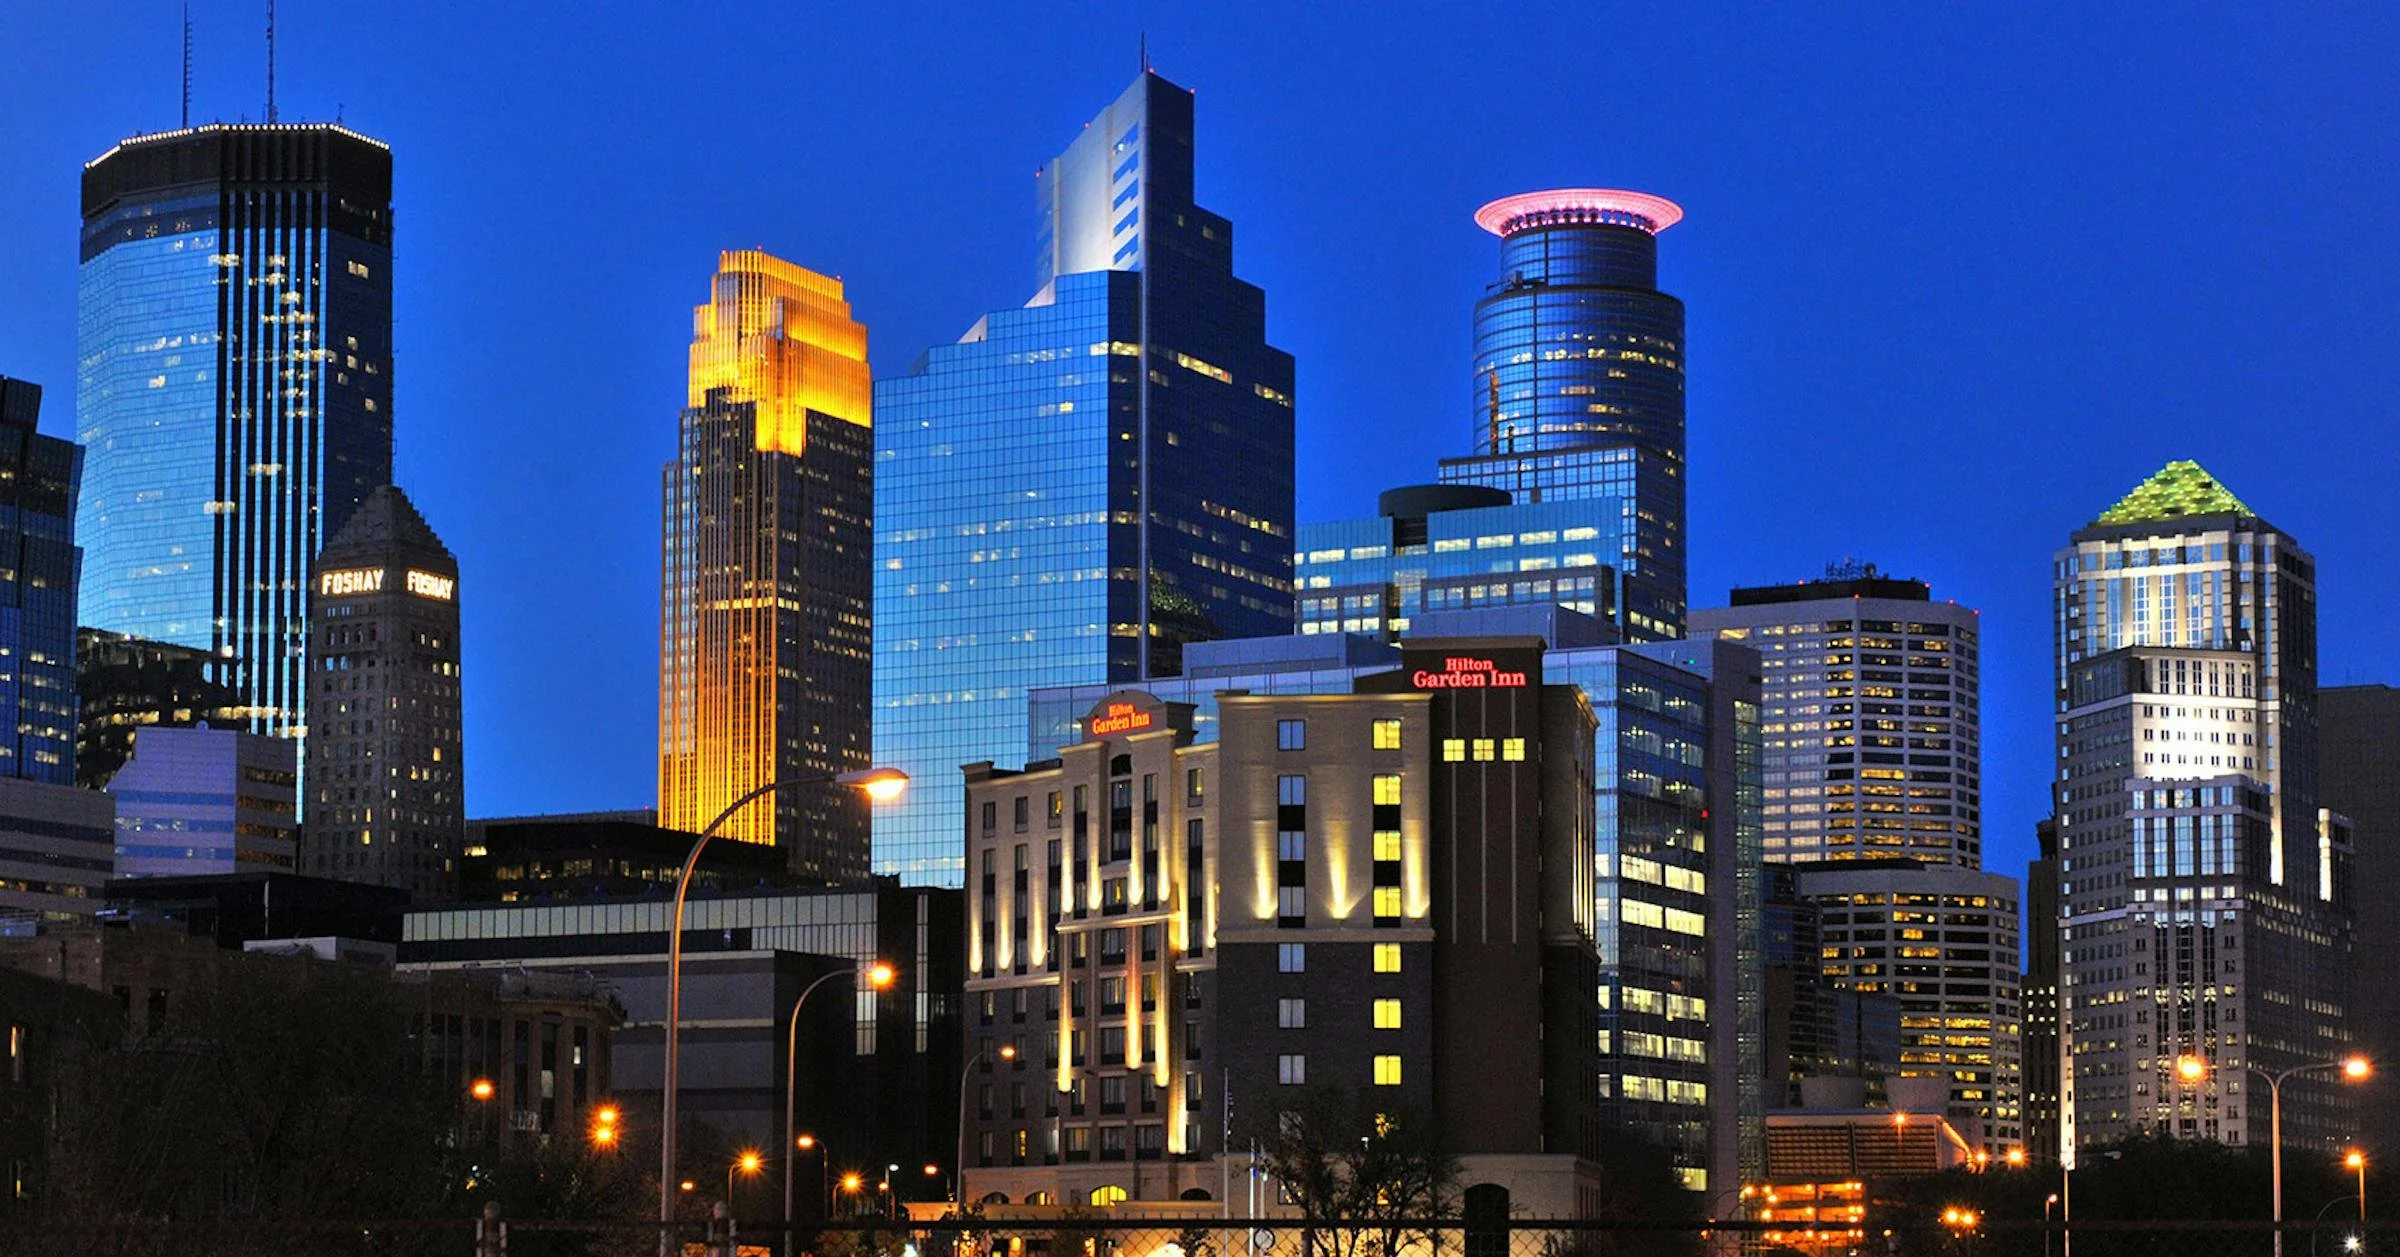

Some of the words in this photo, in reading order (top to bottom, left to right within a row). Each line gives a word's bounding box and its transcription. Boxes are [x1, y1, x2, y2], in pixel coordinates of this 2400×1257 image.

[321, 569, 384, 595] FOSHAY
[407, 570, 453, 600] FOSHAY
[1445, 658, 1494, 672] Hilton
[1413, 671, 1486, 688] Garden
[1490, 670, 1526, 687] Inn
[1093, 717, 1130, 735] Garden
[1130, 712, 1150, 728] Inn
